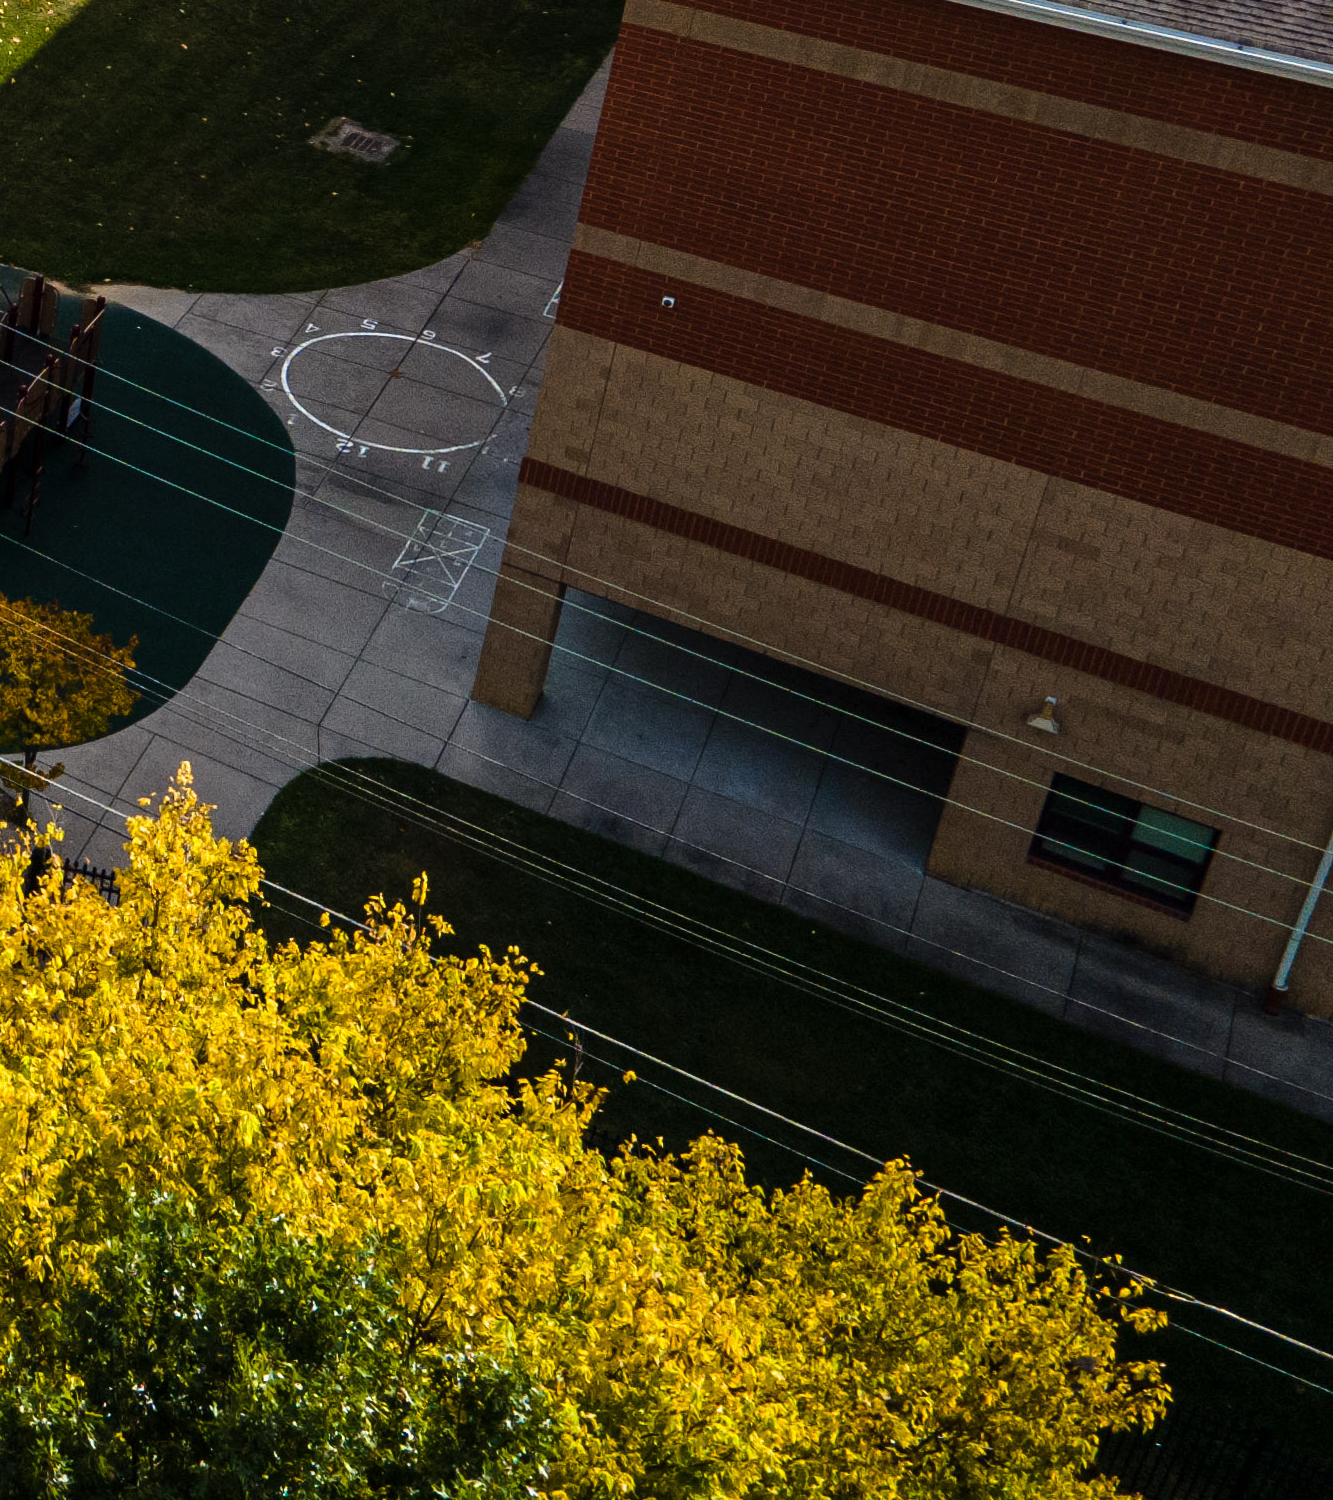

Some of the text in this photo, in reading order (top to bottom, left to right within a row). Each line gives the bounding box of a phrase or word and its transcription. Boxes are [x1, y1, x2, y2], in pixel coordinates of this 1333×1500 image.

[305, 322, 321, 334] 4
[360, 318, 379, 331] 5
[422, 329, 436, 341] 6
[270, 346, 285, 358] 3
[475, 351, 492, 364] 7
[259, 379, 278, 392] 2
[335, 437, 369, 459] 12
[421, 455, 451, 474] 11
